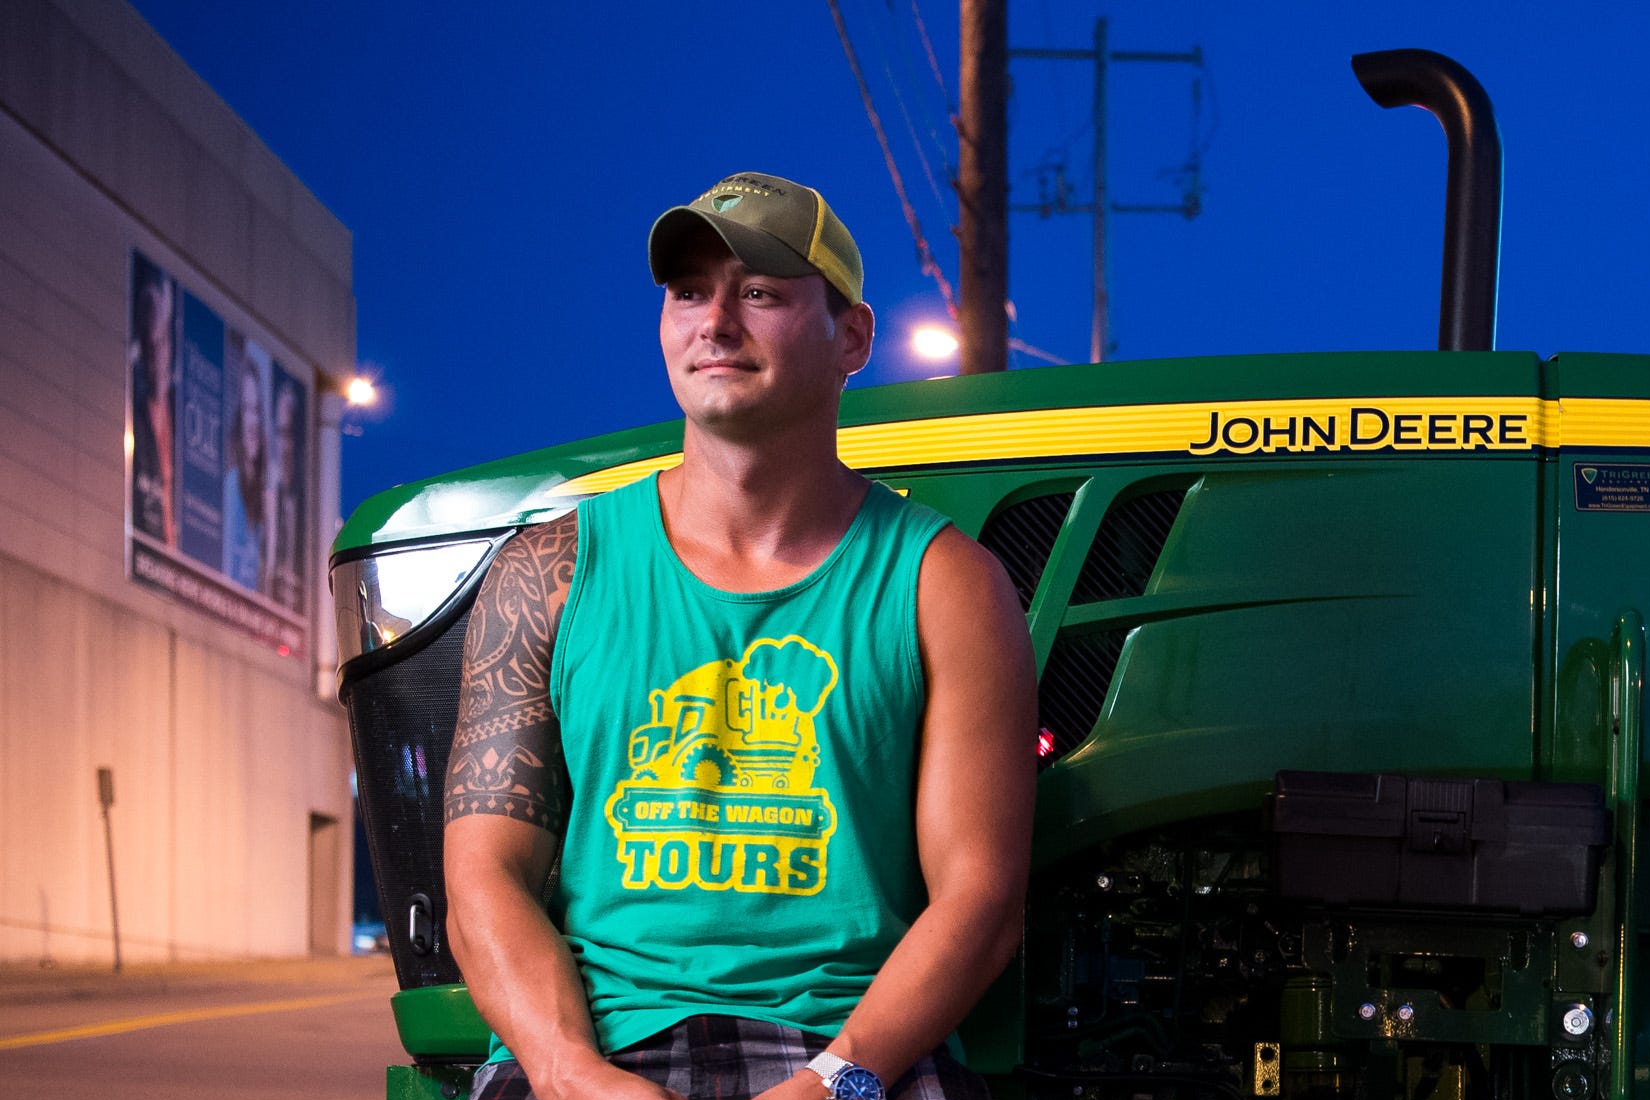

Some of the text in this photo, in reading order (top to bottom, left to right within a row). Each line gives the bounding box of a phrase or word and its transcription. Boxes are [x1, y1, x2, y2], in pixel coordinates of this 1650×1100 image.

[1189, 407, 1528, 450] JOHN DEERE
[635, 801, 814, 826] OFF THE WAGON
[624, 840, 821, 890] TOURS
